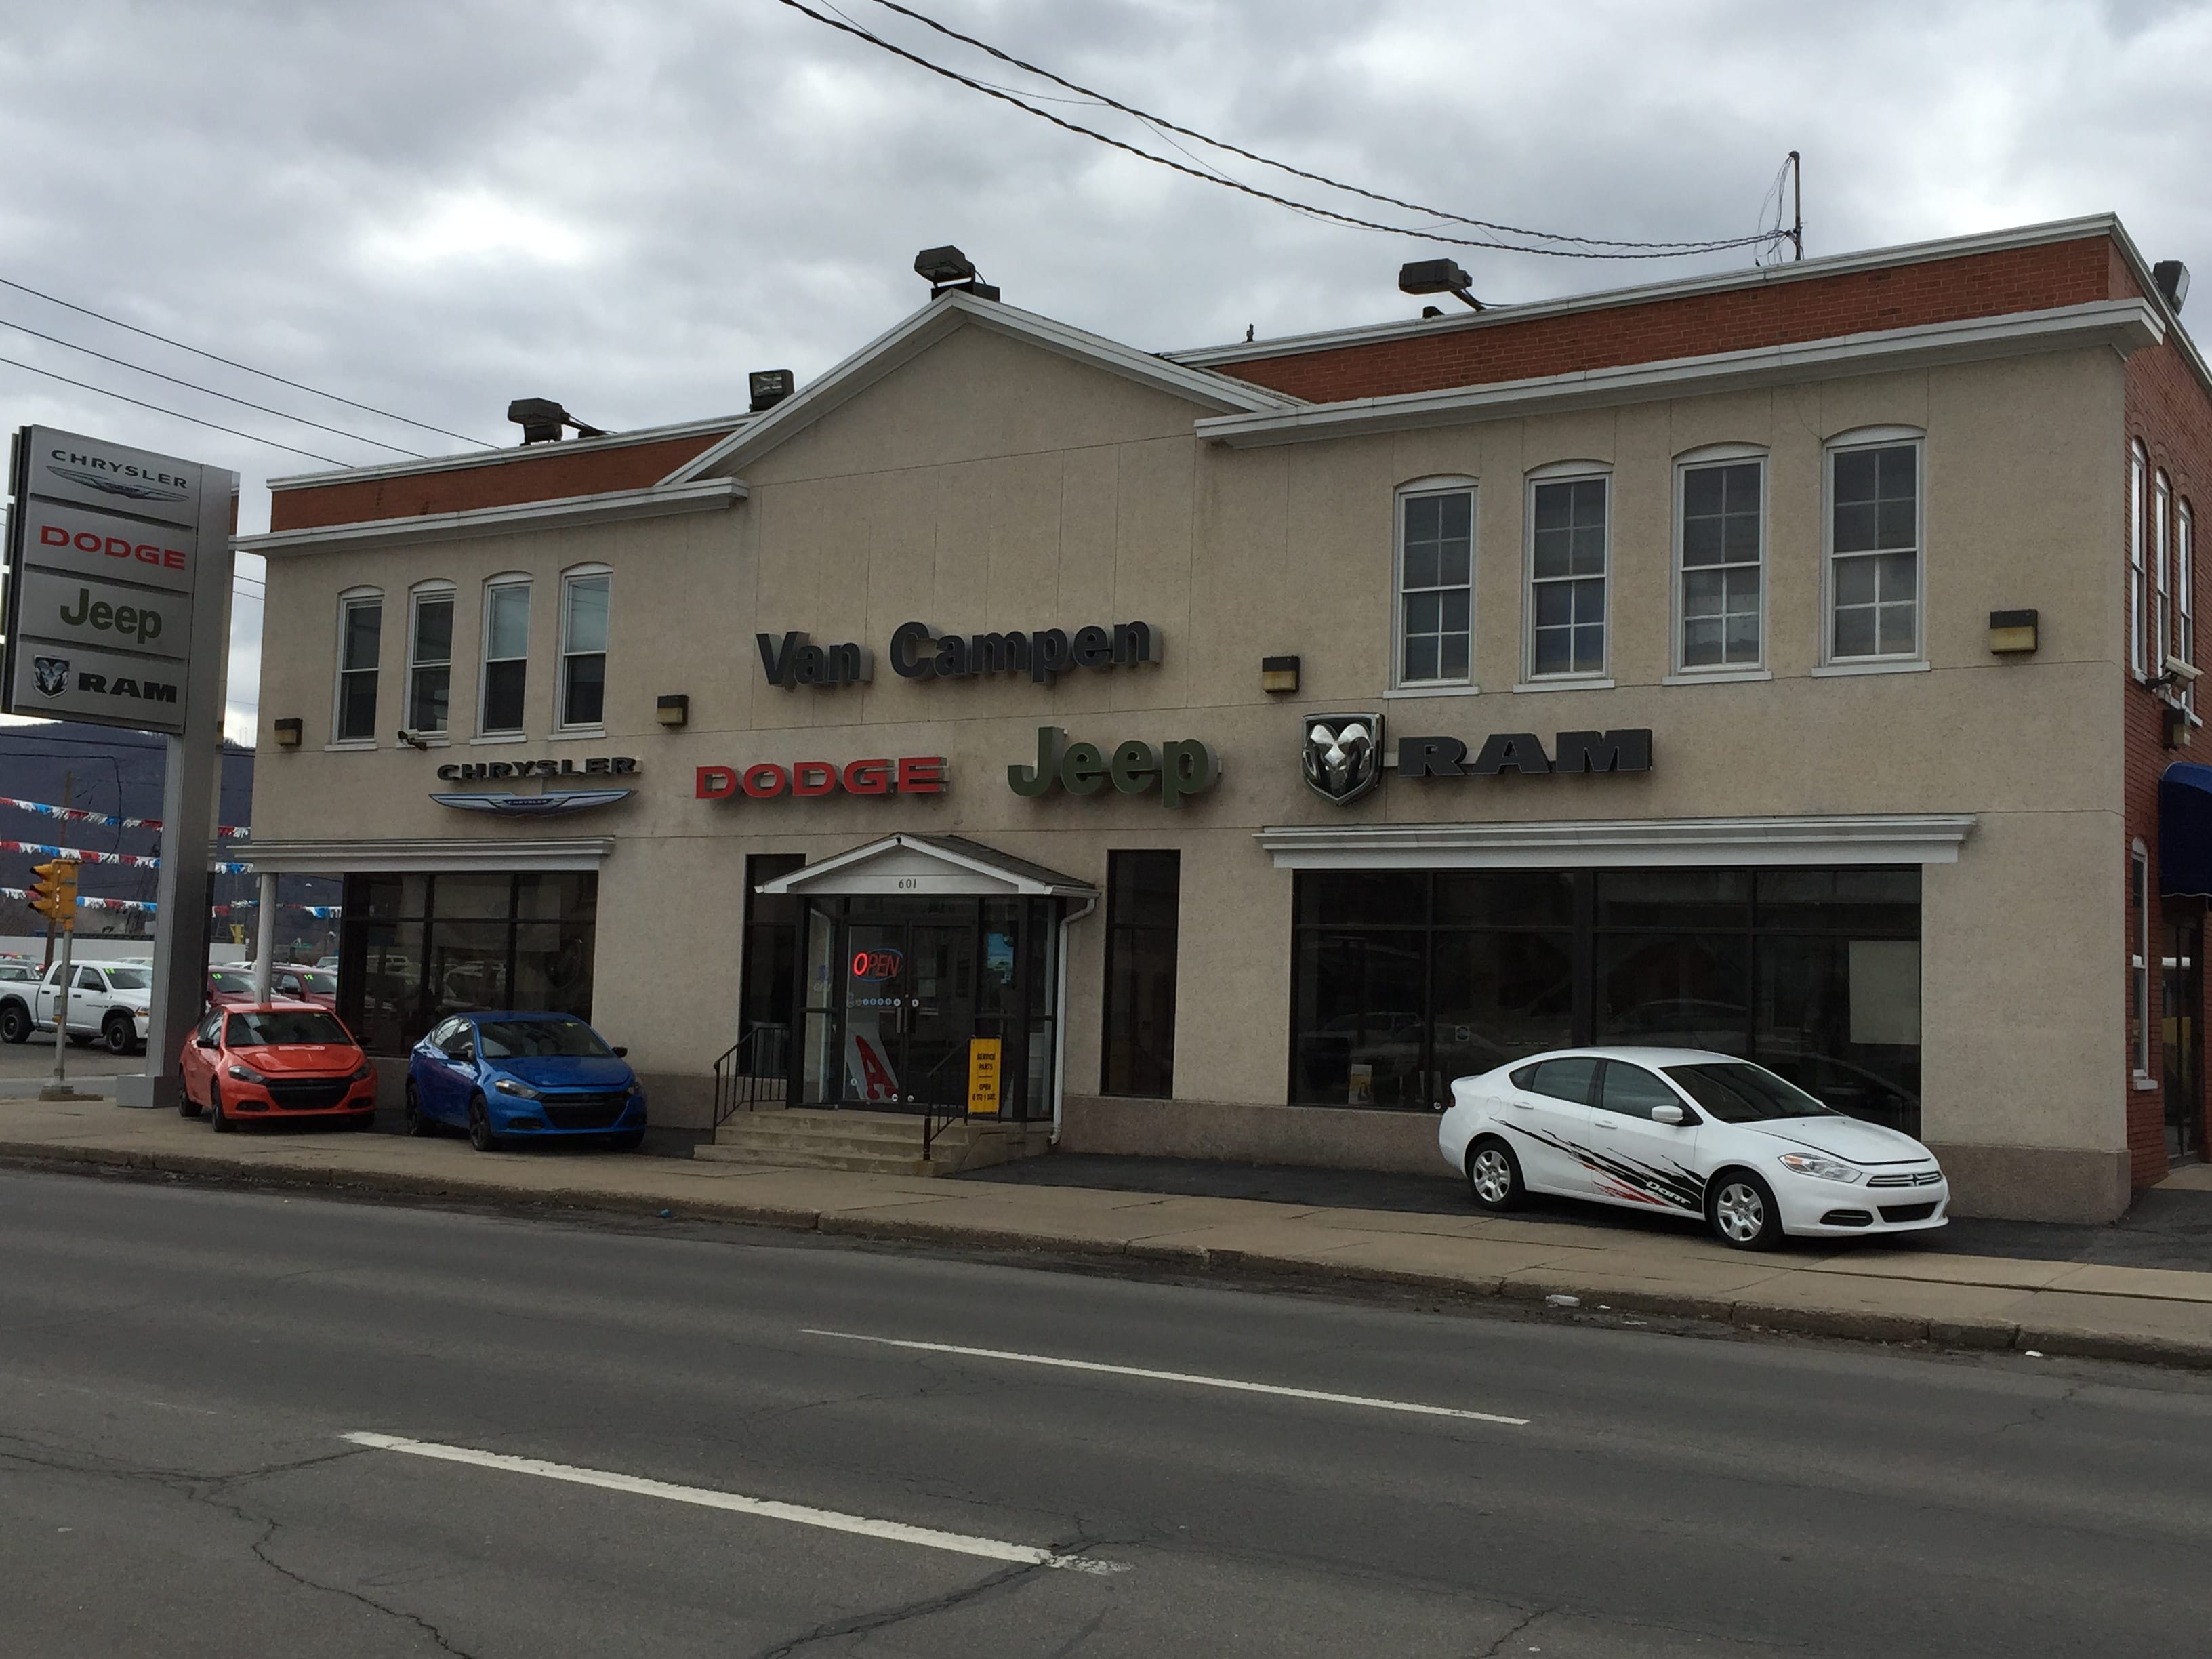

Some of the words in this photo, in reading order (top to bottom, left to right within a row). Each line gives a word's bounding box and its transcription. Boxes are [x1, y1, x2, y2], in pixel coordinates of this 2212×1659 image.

[52, 450, 187, 489] CHRYSLER
[41, 525, 186, 570] DODGE
[60, 588, 162, 644] Jeep
[756, 630, 876, 687] Van
[890, 621, 1162, 684] Campen
[78, 672, 177, 703] RAM
[437, 757, 641, 781] CHRYSLER
[1008, 726, 1221, 808] Jeep
[1398, 728, 1652, 777] RAM
[695, 756, 949, 800] DODGE
[899, 878, 916, 889] 601
[853, 952, 900, 977] OPEN
[979, 1063, 993, 1071] PARTS
